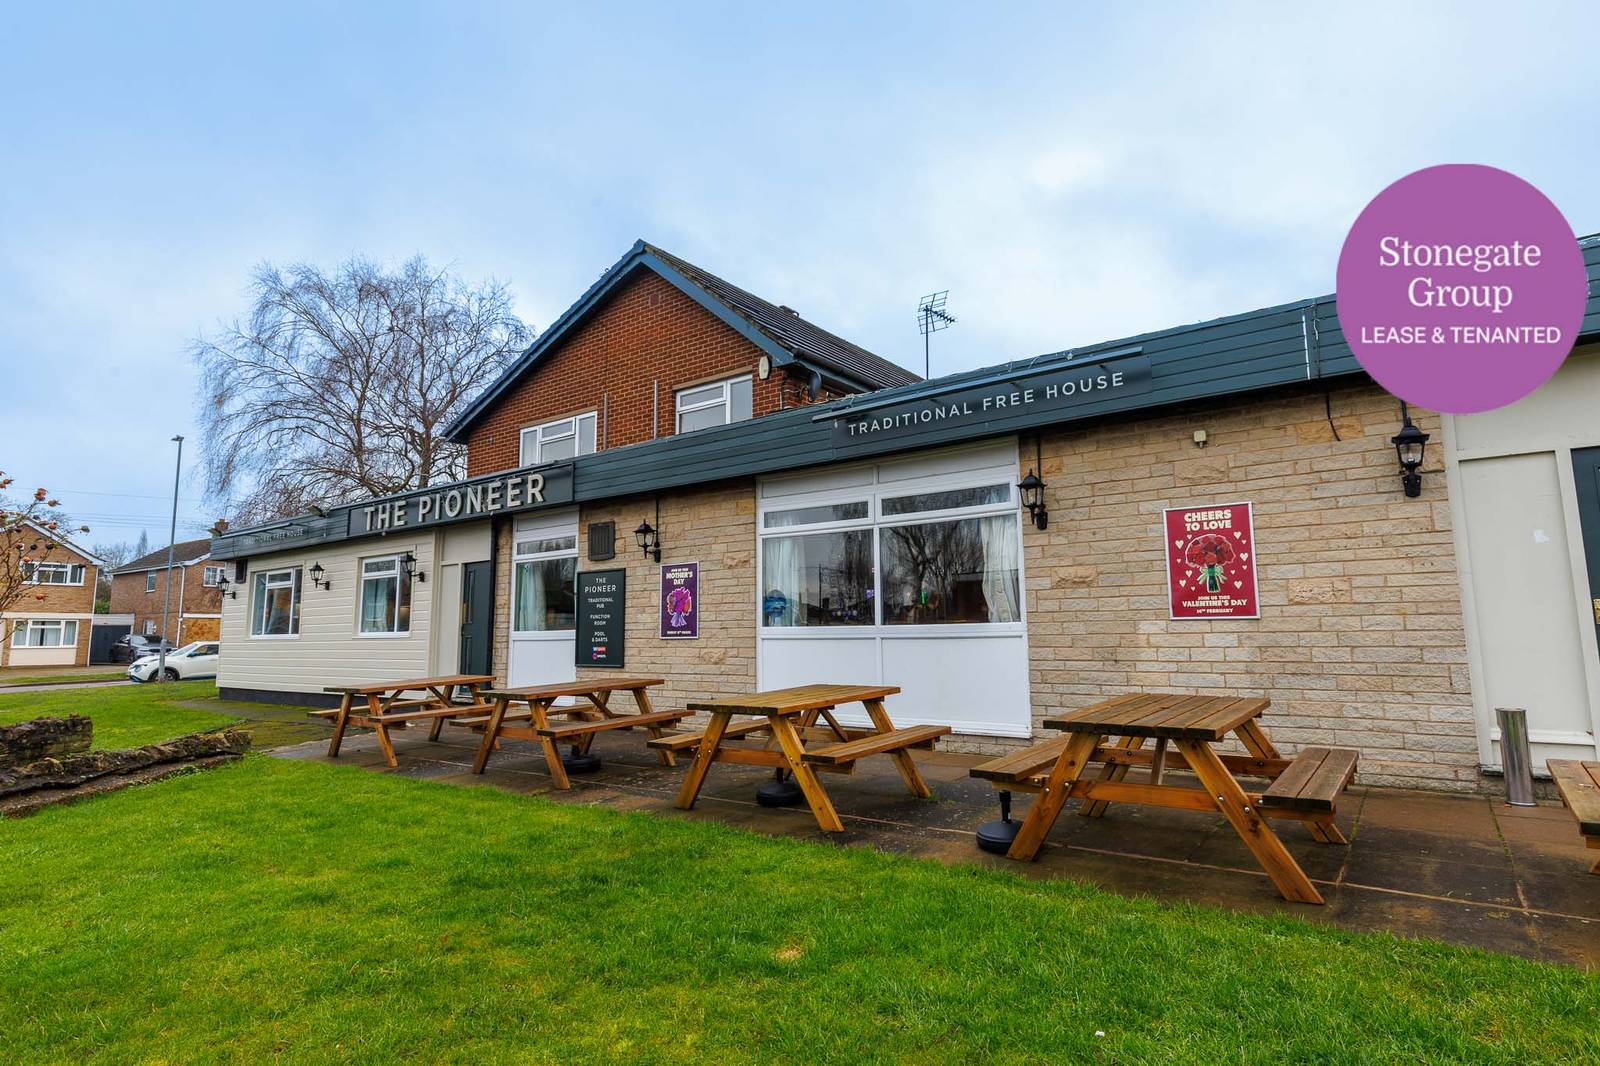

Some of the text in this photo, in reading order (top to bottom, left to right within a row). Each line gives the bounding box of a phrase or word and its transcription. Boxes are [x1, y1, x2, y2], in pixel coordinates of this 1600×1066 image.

[848, 372, 1124, 436] TRADITIONAL FREE HOUSE
[364, 473, 545, 531] THE PIONEER
[1184, 509, 1232, 522] CHEERS
[1185, 520, 1232, 532] TO LOVE
[584, 584, 617, 593] PIONEER
[1182, 599, 1230, 607] VALENTINE'S
